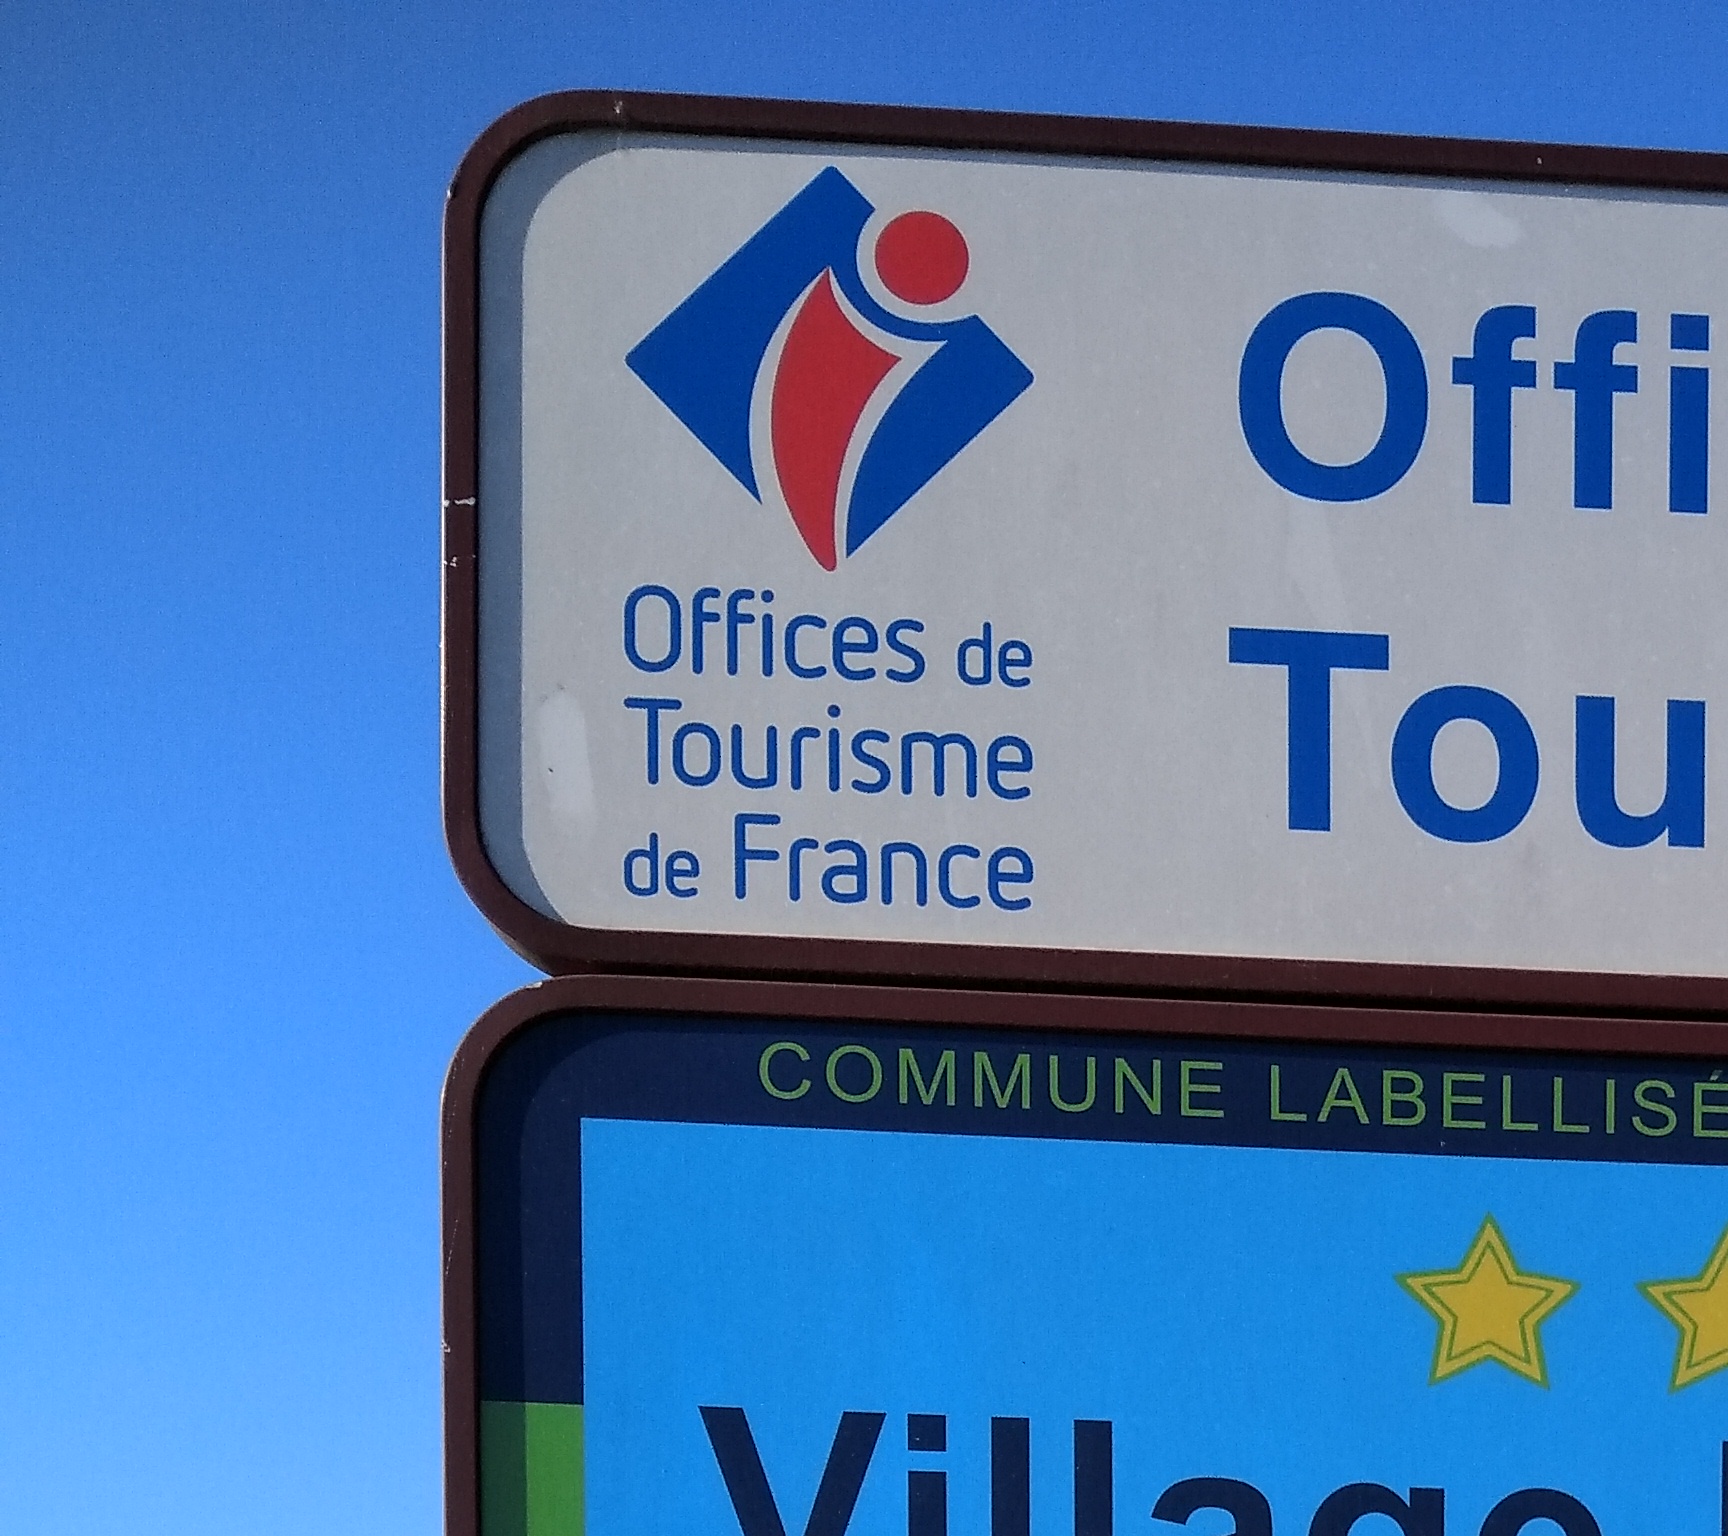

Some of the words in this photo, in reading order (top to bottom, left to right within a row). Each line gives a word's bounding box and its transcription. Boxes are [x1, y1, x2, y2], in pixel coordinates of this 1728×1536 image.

[623, 584, 926, 683] Offices
[957, 622, 1033, 687] de
[624, 697, 1033, 800] Tourisme
[624, 832, 699, 897] de
[734, 813, 1033, 910] France
[758, 1041, 1225, 1119] COMMUNE
